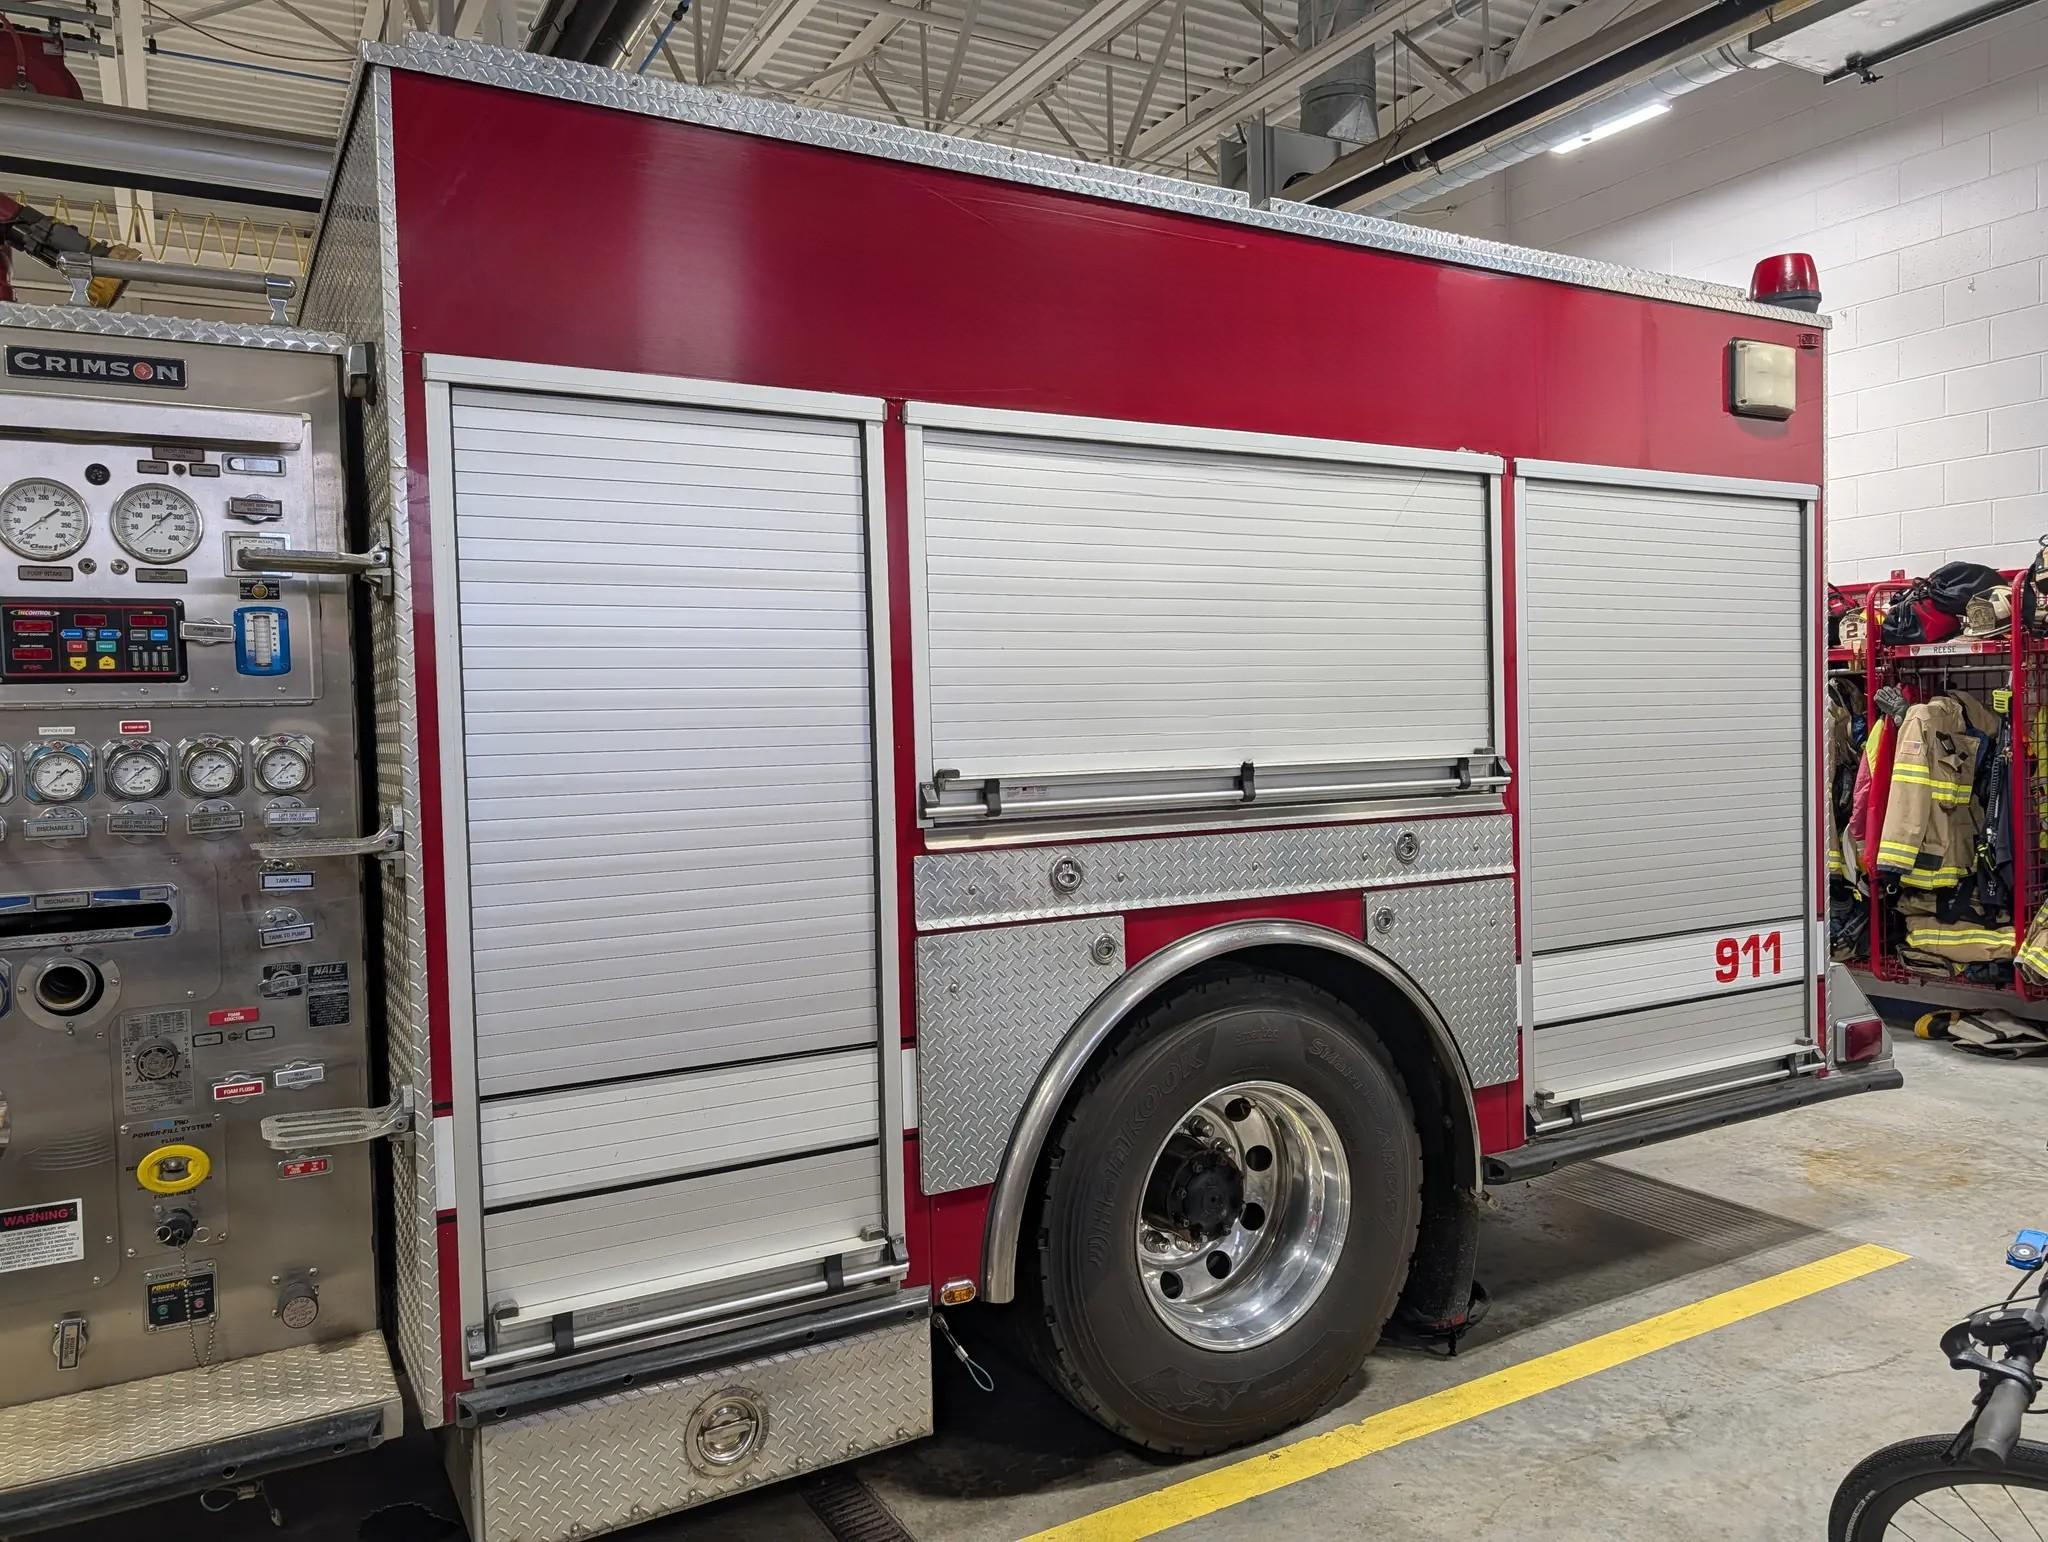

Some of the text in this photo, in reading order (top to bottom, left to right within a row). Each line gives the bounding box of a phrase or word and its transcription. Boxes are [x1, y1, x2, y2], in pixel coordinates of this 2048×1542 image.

[14, 352, 179, 381] CRIMSON
[1846, 622, 1858, 639] 2
[1933, 645, 1957, 654] REESE
[1716, 931, 1781, 983] 911
[313, 964, 343, 975] HALE
[181, 1122, 212, 1132] SYSTEM
[161, 1136, 185, 1144] FLUSH
[4, 1208, 69, 1227] WARNING
